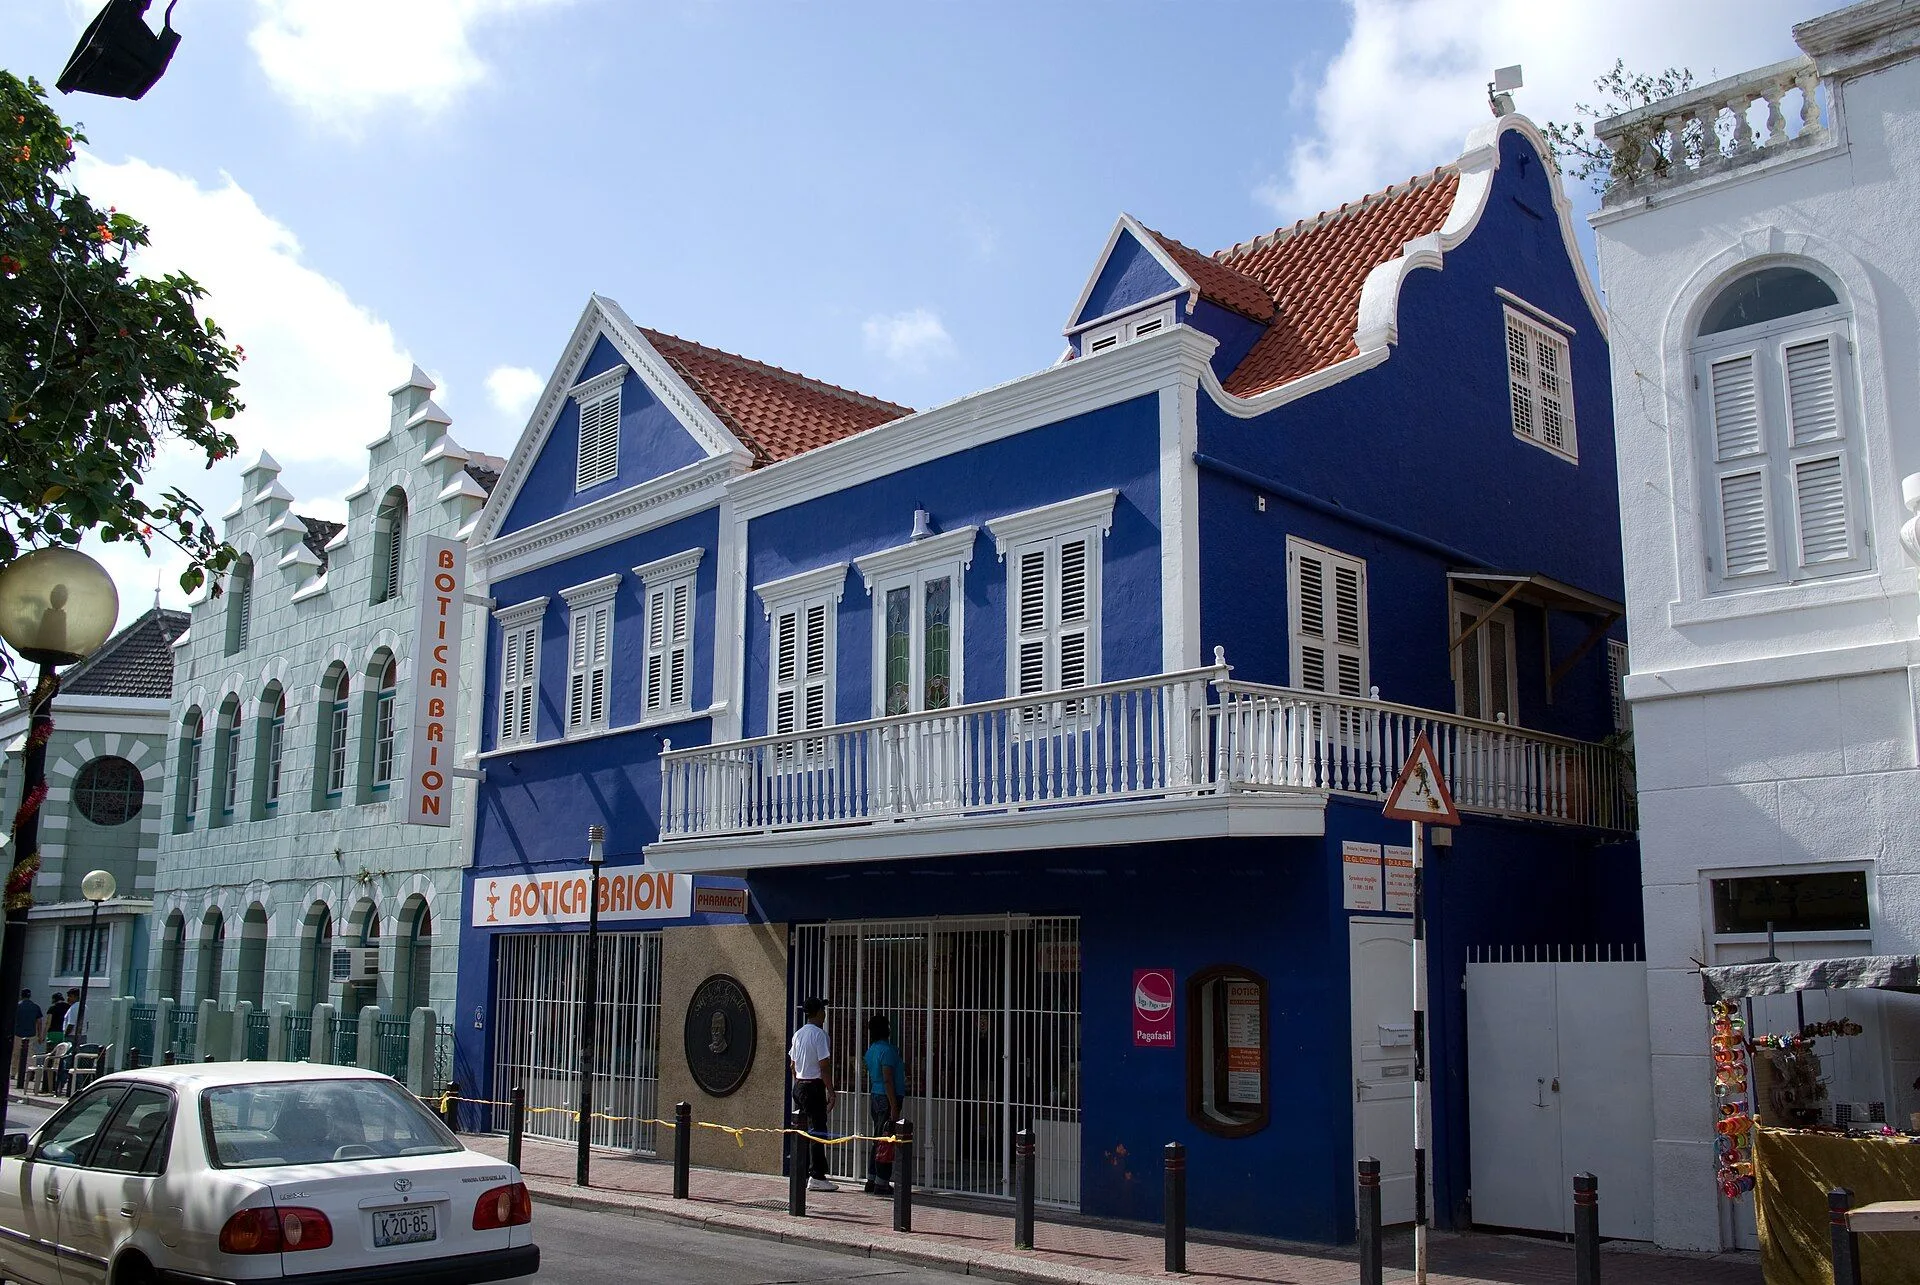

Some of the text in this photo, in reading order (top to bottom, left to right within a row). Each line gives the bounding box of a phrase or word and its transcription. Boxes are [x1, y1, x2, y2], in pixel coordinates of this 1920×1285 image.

[421, 549, 456, 816] BOTICA BRION
[509, 872, 675, 918] BOTICA BRION
[697, 894, 743, 907] PHARMACY
[1136, 1030, 1172, 1043] Pagafasil
